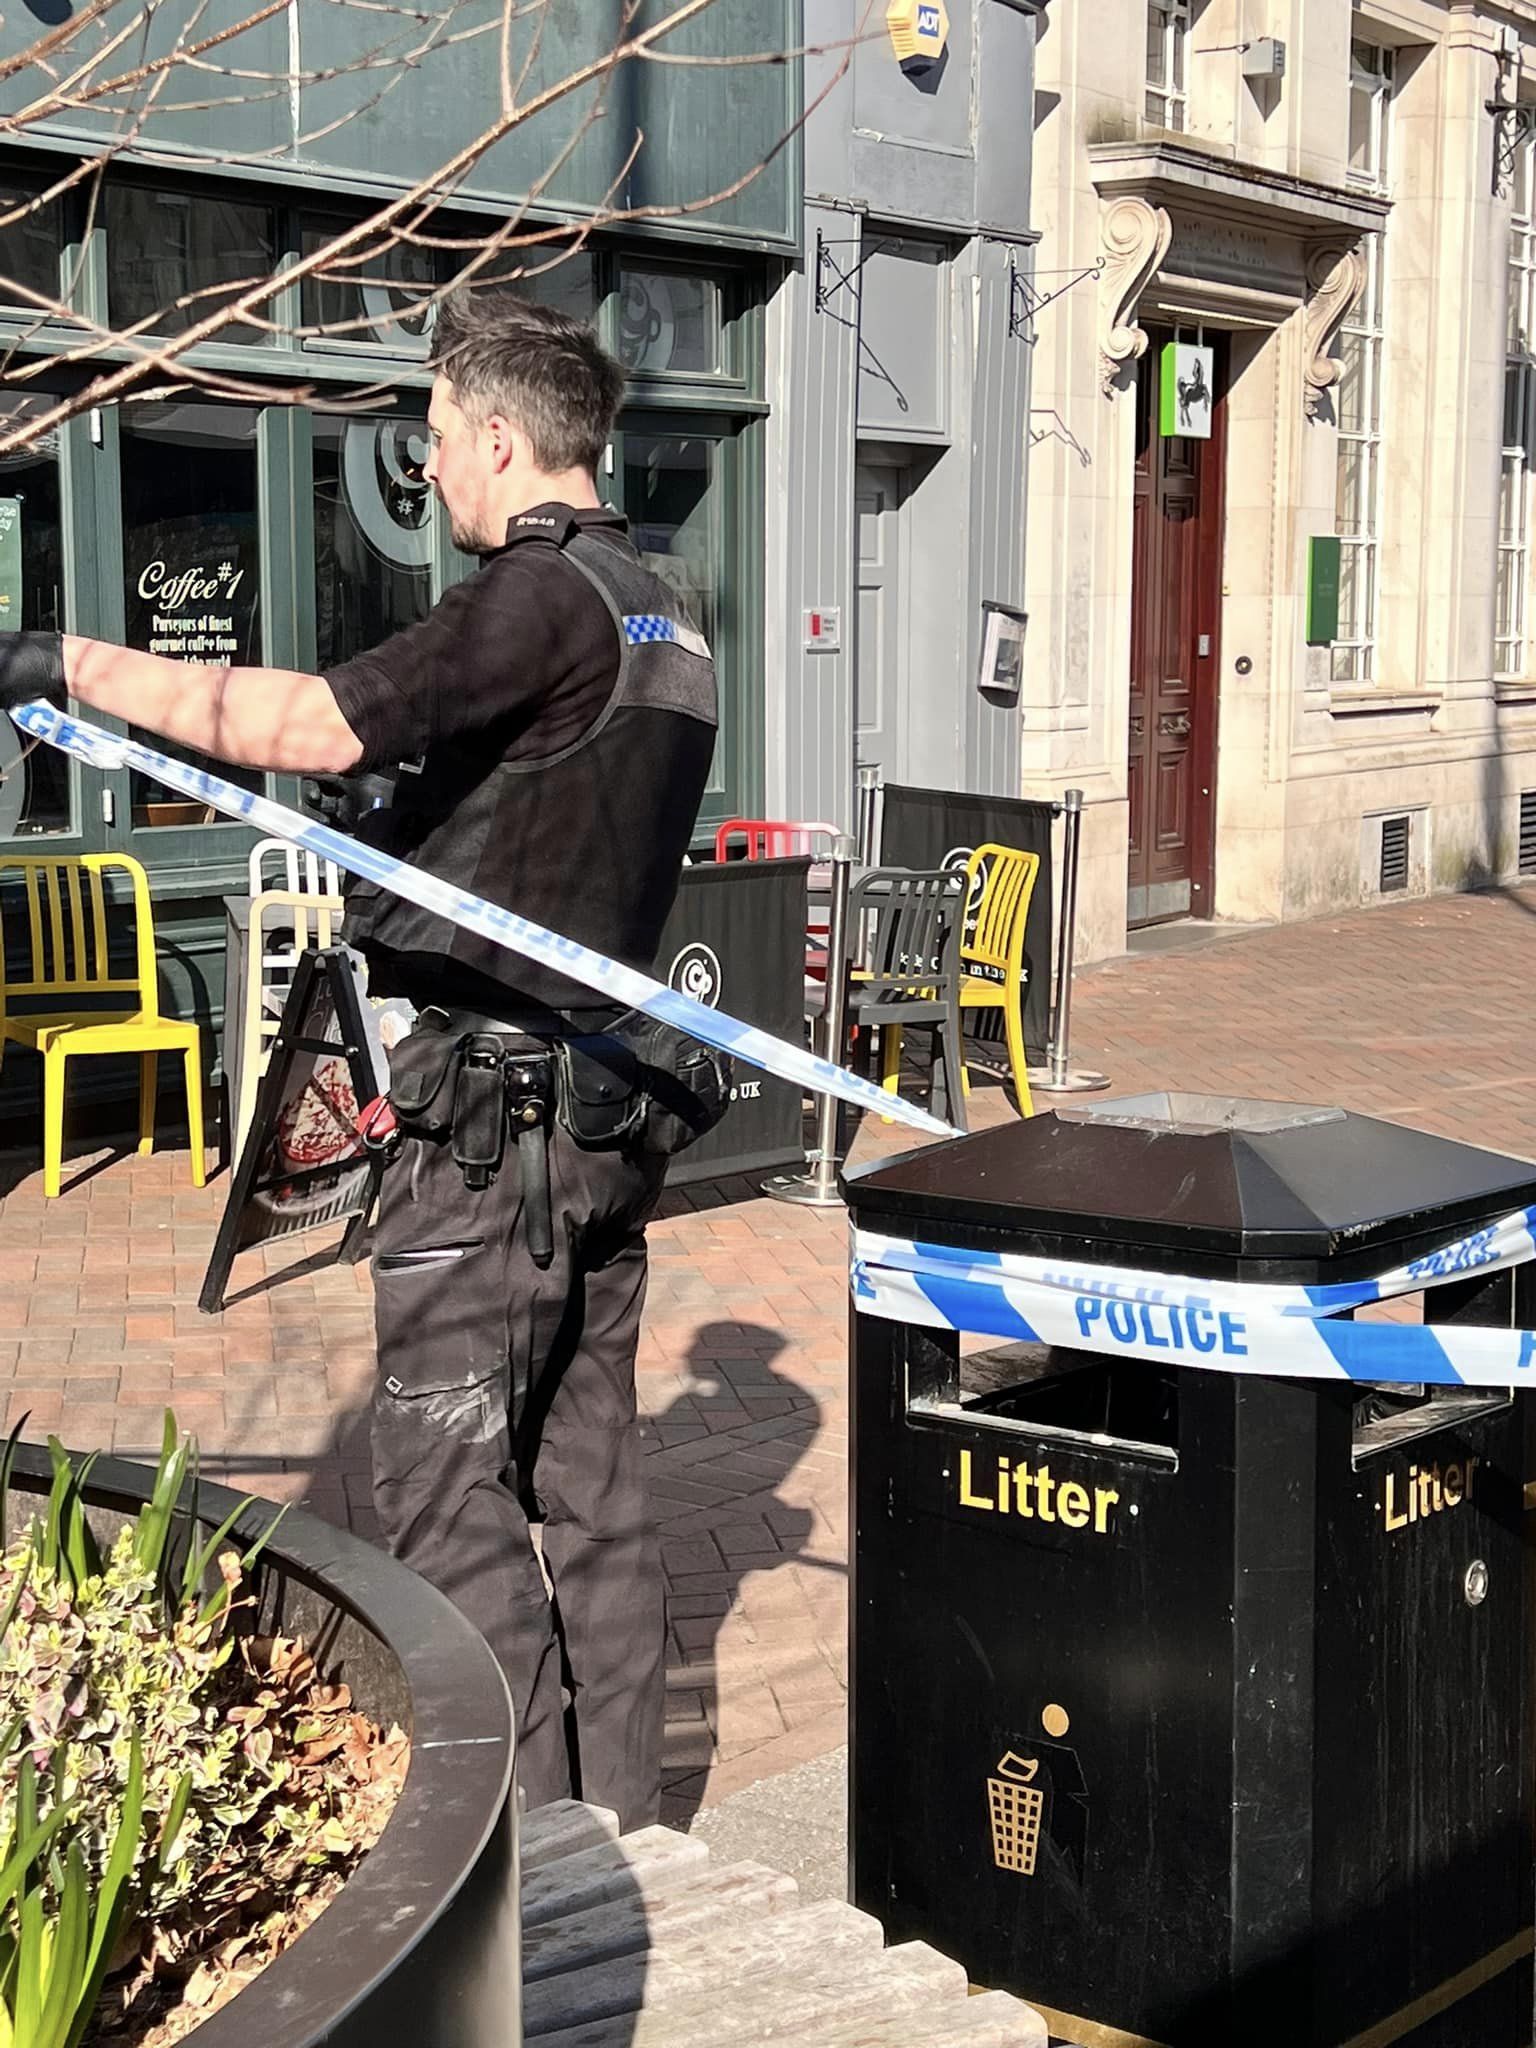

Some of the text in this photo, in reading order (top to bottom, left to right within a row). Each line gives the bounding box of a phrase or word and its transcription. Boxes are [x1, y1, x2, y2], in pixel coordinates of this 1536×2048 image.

[918, 8, 940, 33] ADT
[152, 614, 197, 636] Purveyors
[198, 614, 208, 632] of
[216, 634, 238, 652] from
[740, 1081, 761, 1099] UK
[1074, 1295, 1250, 1356] POLICE
[959, 1449, 1120, 1534] Litter
[1385, 1457, 1480, 1533] Litter
